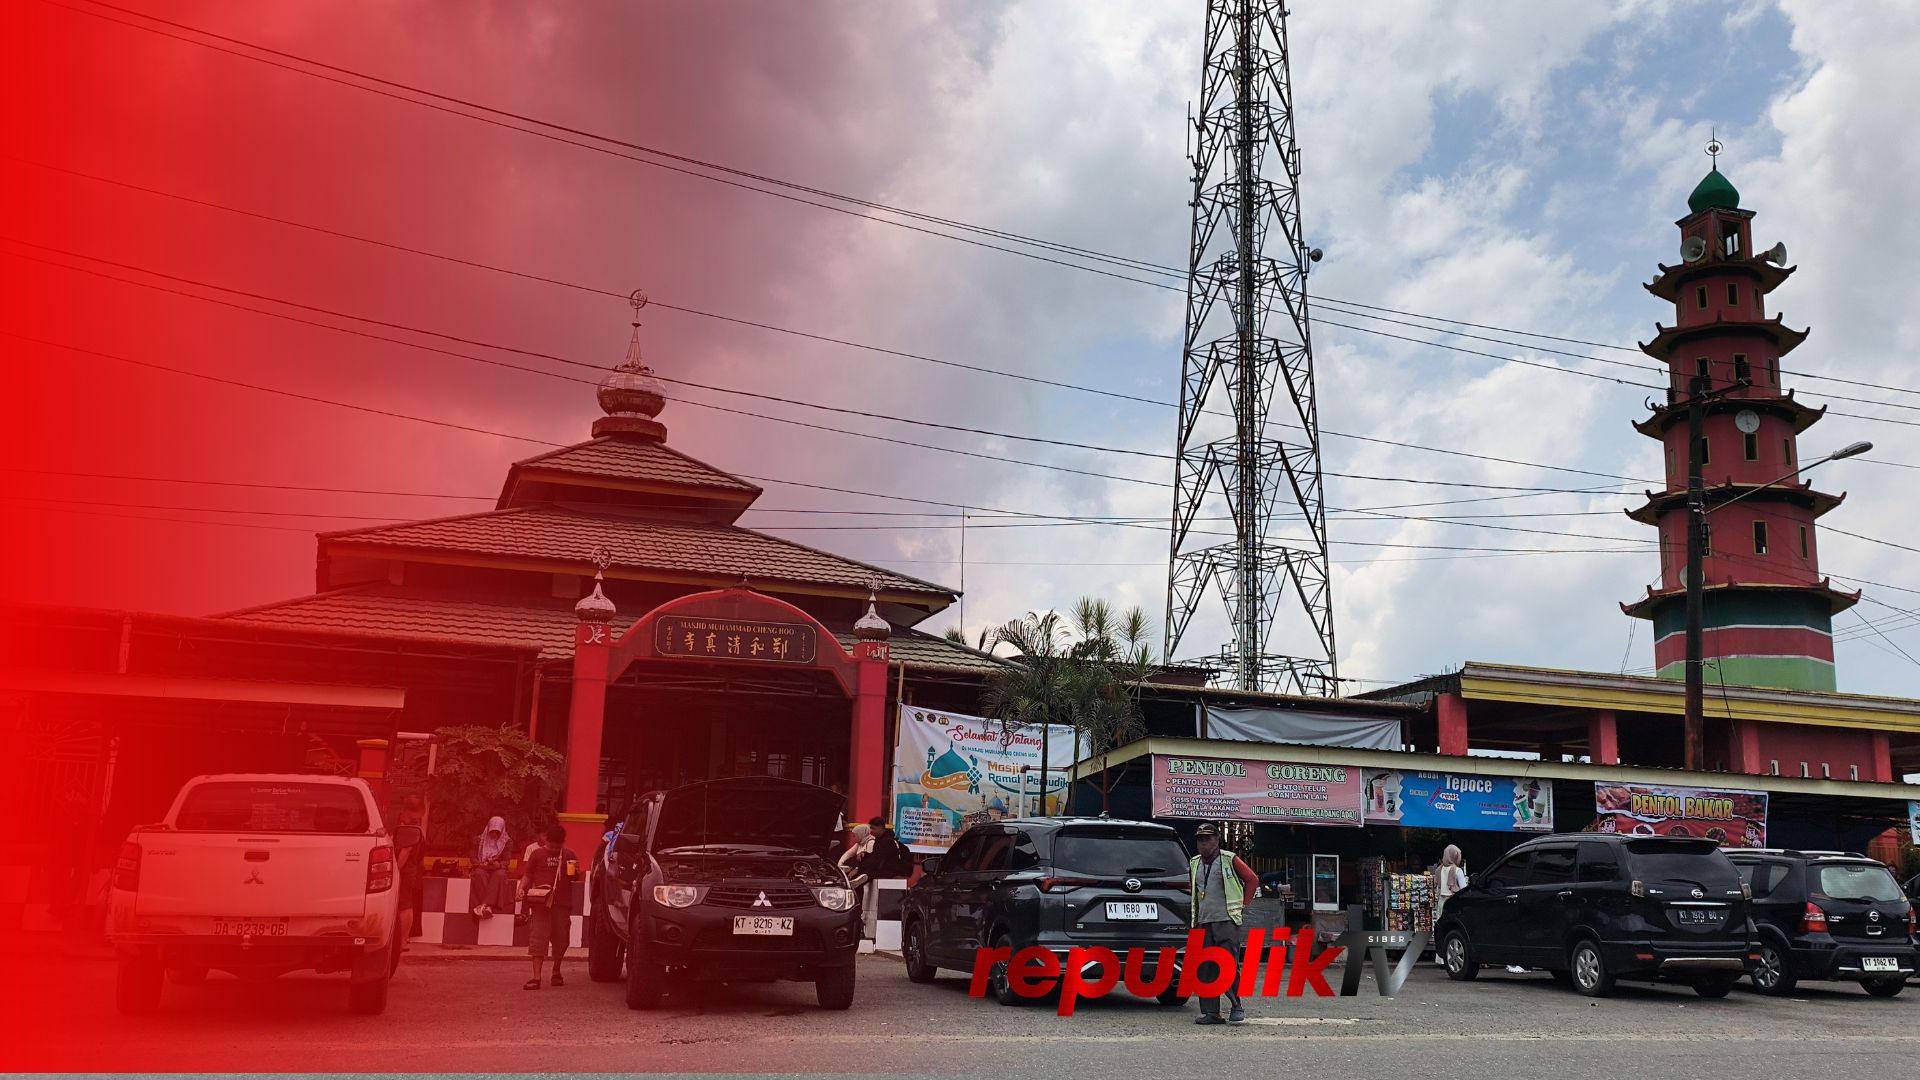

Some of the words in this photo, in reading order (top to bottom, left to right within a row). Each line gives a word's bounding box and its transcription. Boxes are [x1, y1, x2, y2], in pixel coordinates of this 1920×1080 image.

[680, 622, 706, 630] MASJID
[708, 622, 752, 632] MUHAMMAD
[752, 624, 778, 634] CHENG
[778, 626, 794, 636] HOO
[946, 725, 1000, 742] Selamat
[988, 760, 1023, 774] Masji
[1168, 758, 1247, 778] PENTOL
[1266, 764, 1347, 783] GORENG
[1026, 776, 1068, 788] Peudik
[1631, 793, 1682, 817] PENTOL
[1684, 796, 1734, 820] BAKAR
[1108, 904, 1117, 913] KT
[1124, 904, 1140, 913] 1680
[1146, 904, 1156, 914] YN
[214, 922, 228, 934] DA
[236, 923, 265, 935] 8238
[736, 918, 746, 928] KT
[754, 918, 772, 928] 8216
[780, 918, 792, 930] KZ
